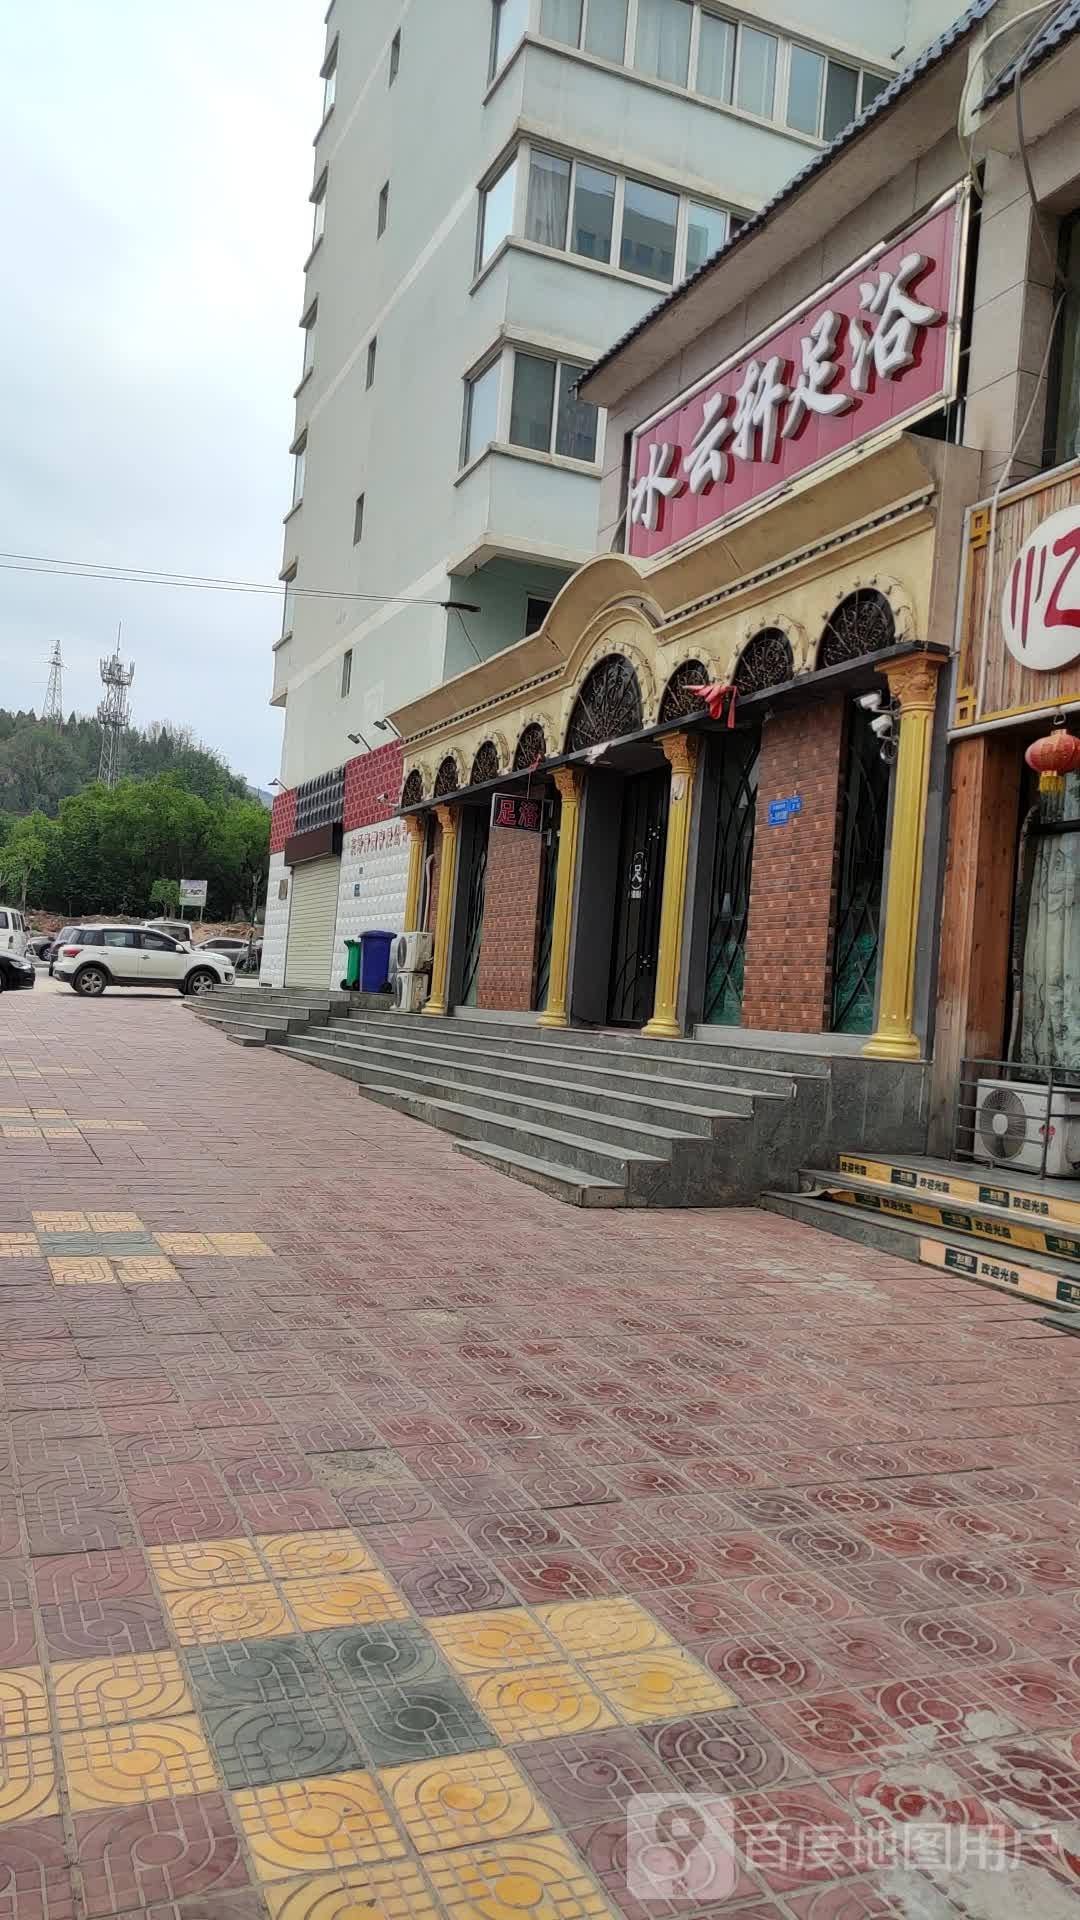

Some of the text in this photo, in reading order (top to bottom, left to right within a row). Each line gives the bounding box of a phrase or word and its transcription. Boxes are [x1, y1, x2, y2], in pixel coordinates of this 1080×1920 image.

[631, 252, 943, 532] 水云轩足浴
[496, 799, 539, 828] 足浴
